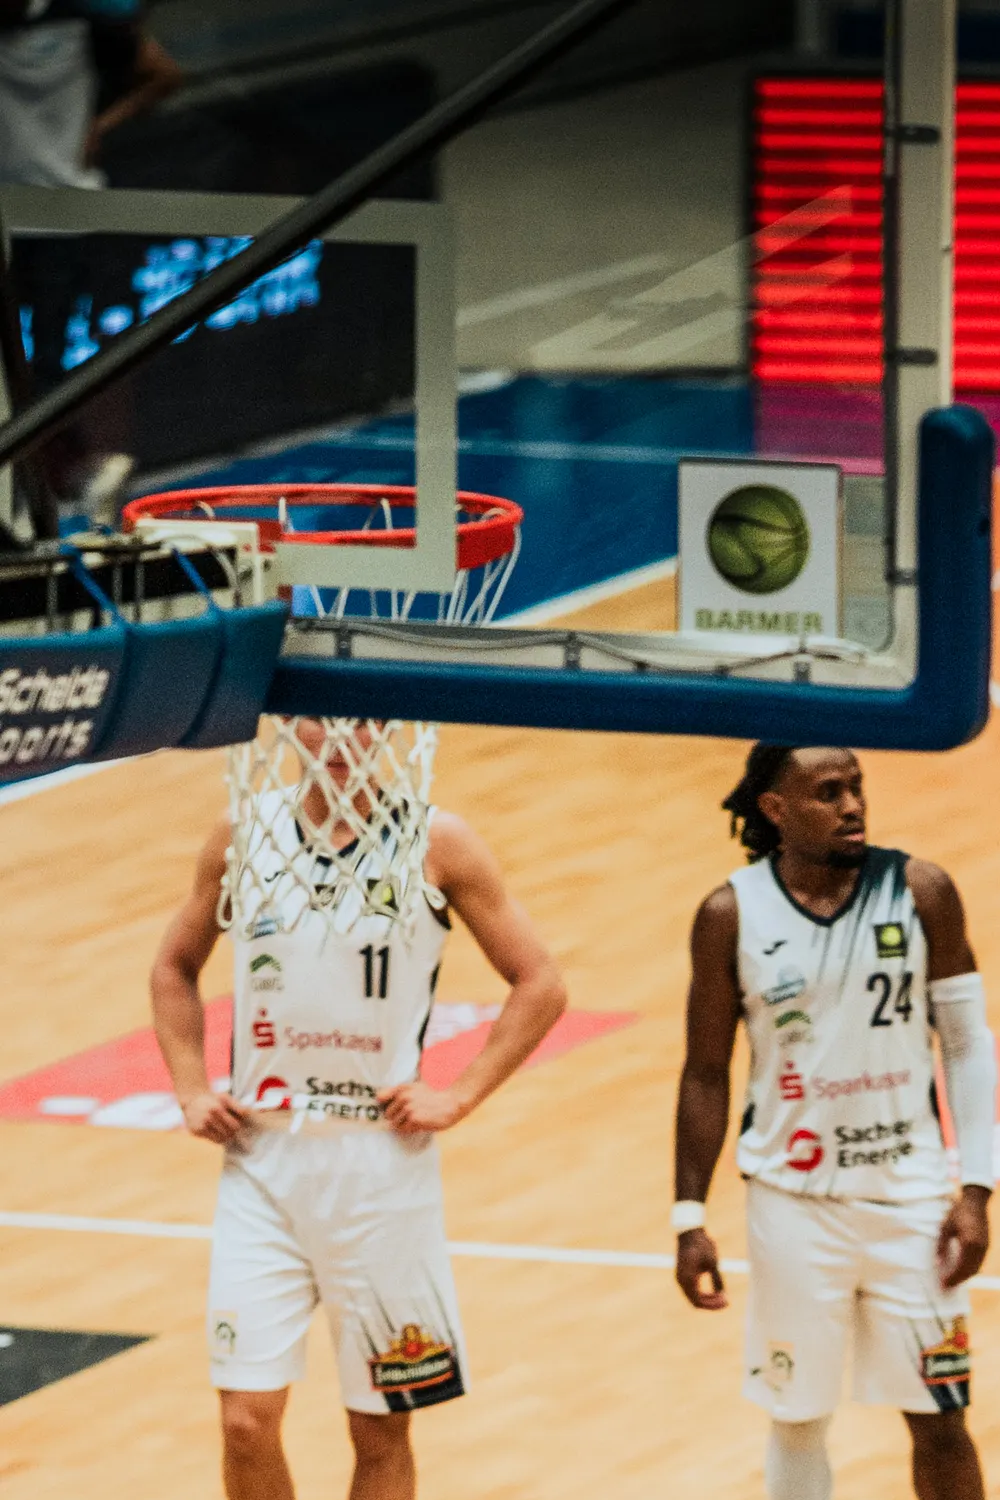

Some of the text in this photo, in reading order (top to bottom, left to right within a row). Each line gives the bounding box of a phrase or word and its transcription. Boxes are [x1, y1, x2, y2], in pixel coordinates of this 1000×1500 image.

[694, 608, 822, 634] BARMER
[0, 717, 93, 764] ports
[359, 943, 390, 999] 11
[867, 971, 913, 1028] 24
[306, 1076, 377, 1099] Sachs
[307, 1100, 381, 1121] Energ
